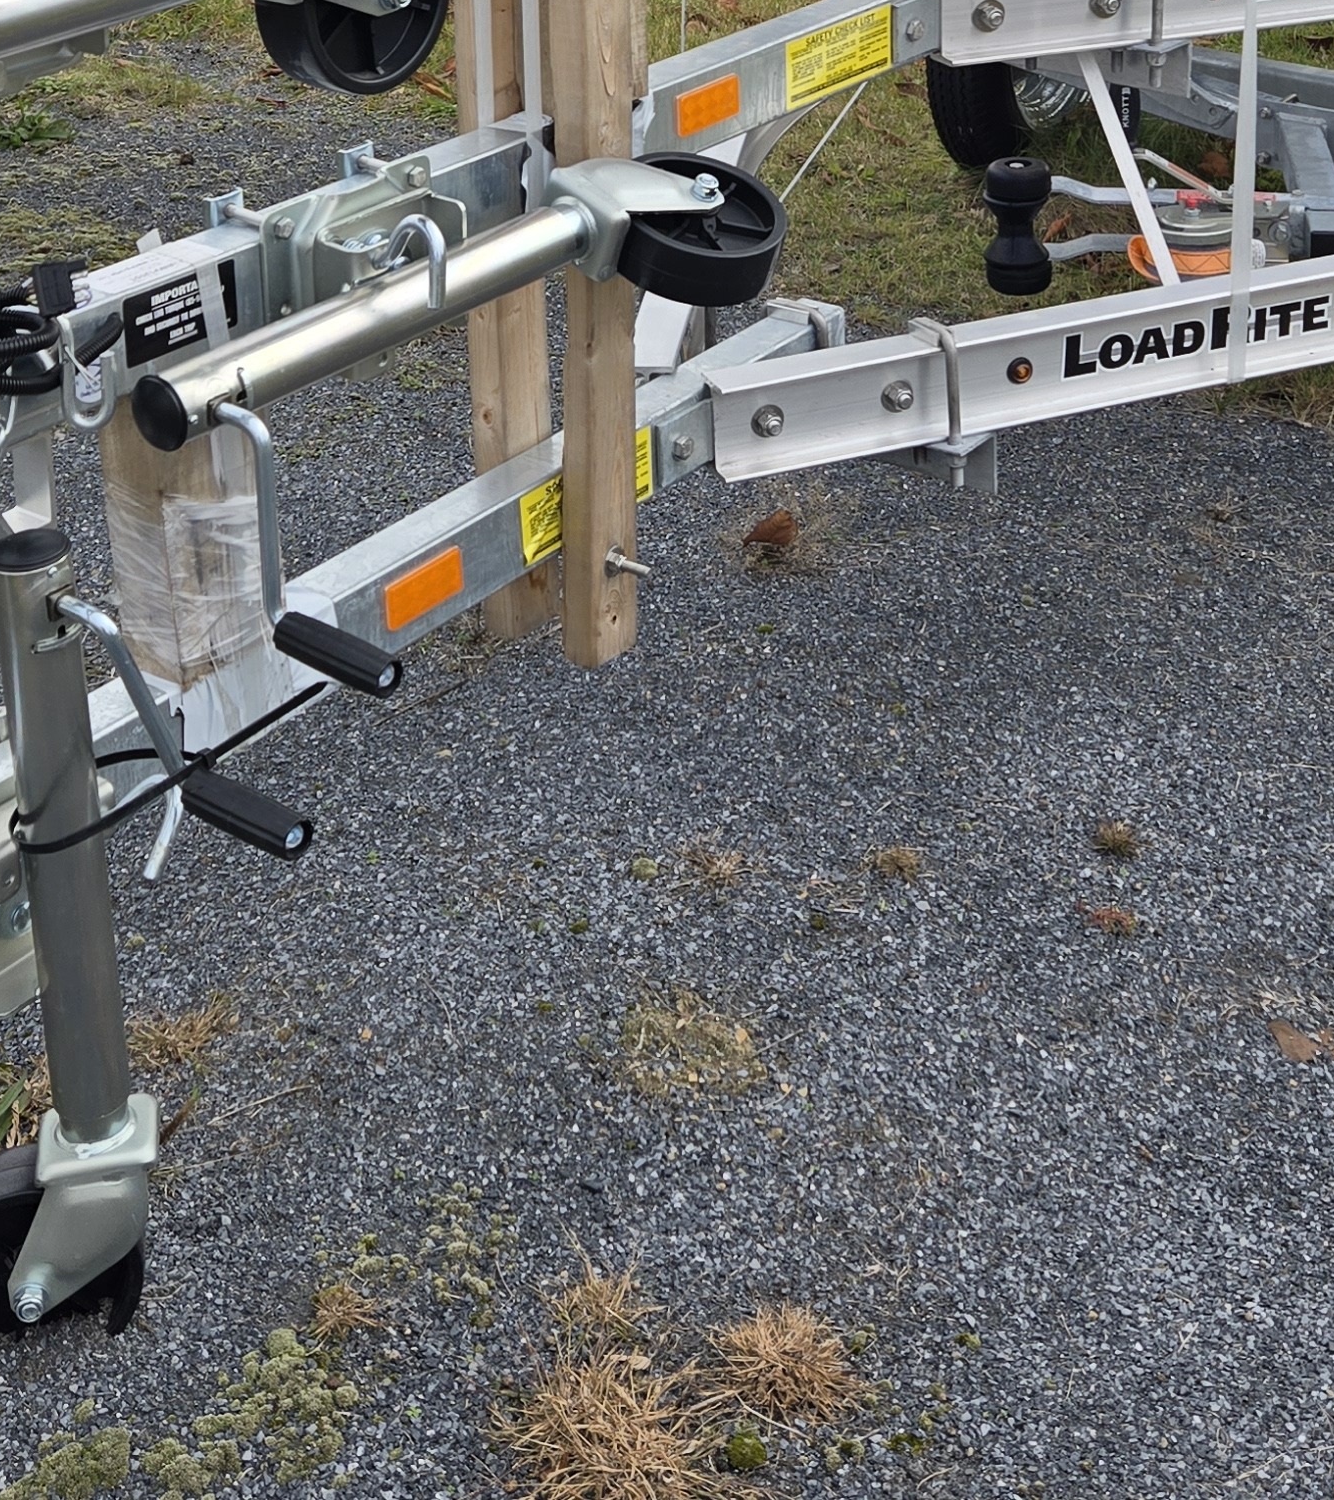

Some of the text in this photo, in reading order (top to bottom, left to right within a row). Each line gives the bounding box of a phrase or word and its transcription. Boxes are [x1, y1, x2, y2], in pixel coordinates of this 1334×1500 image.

[805, 13, 875, 47] SAFETY CHECK LIST
[151, 280, 198, 306] IMPORTA
